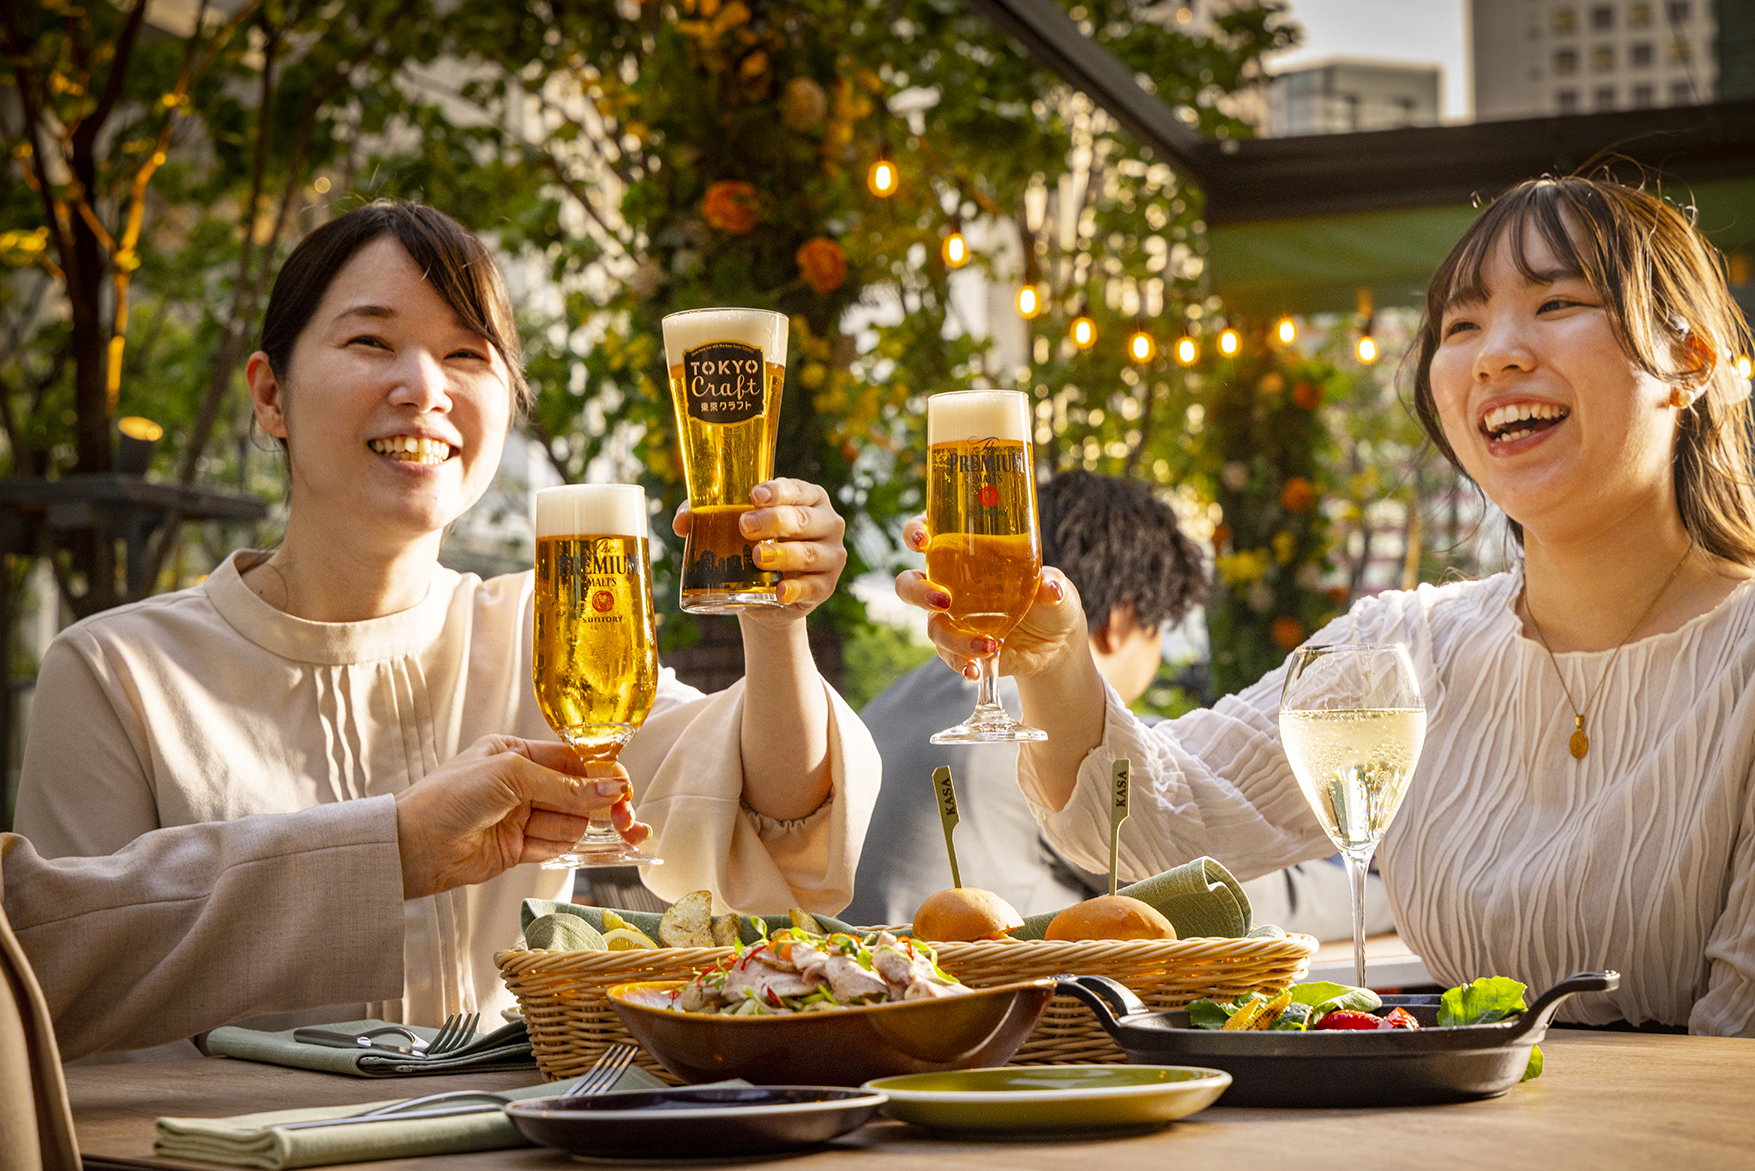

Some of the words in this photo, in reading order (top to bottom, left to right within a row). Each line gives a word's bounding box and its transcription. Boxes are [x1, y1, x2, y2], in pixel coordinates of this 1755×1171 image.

[690, 360, 758, 375] TOKYO
[691, 374, 760, 400] Craft
[700, 401, 751, 412] 東京クラフト
[950, 452, 1024, 473] PREMIUM
[559, 553, 640, 576] PREMIUM
[941, 777, 956, 816] KASA
[1116, 770, 1127, 808] KASA
